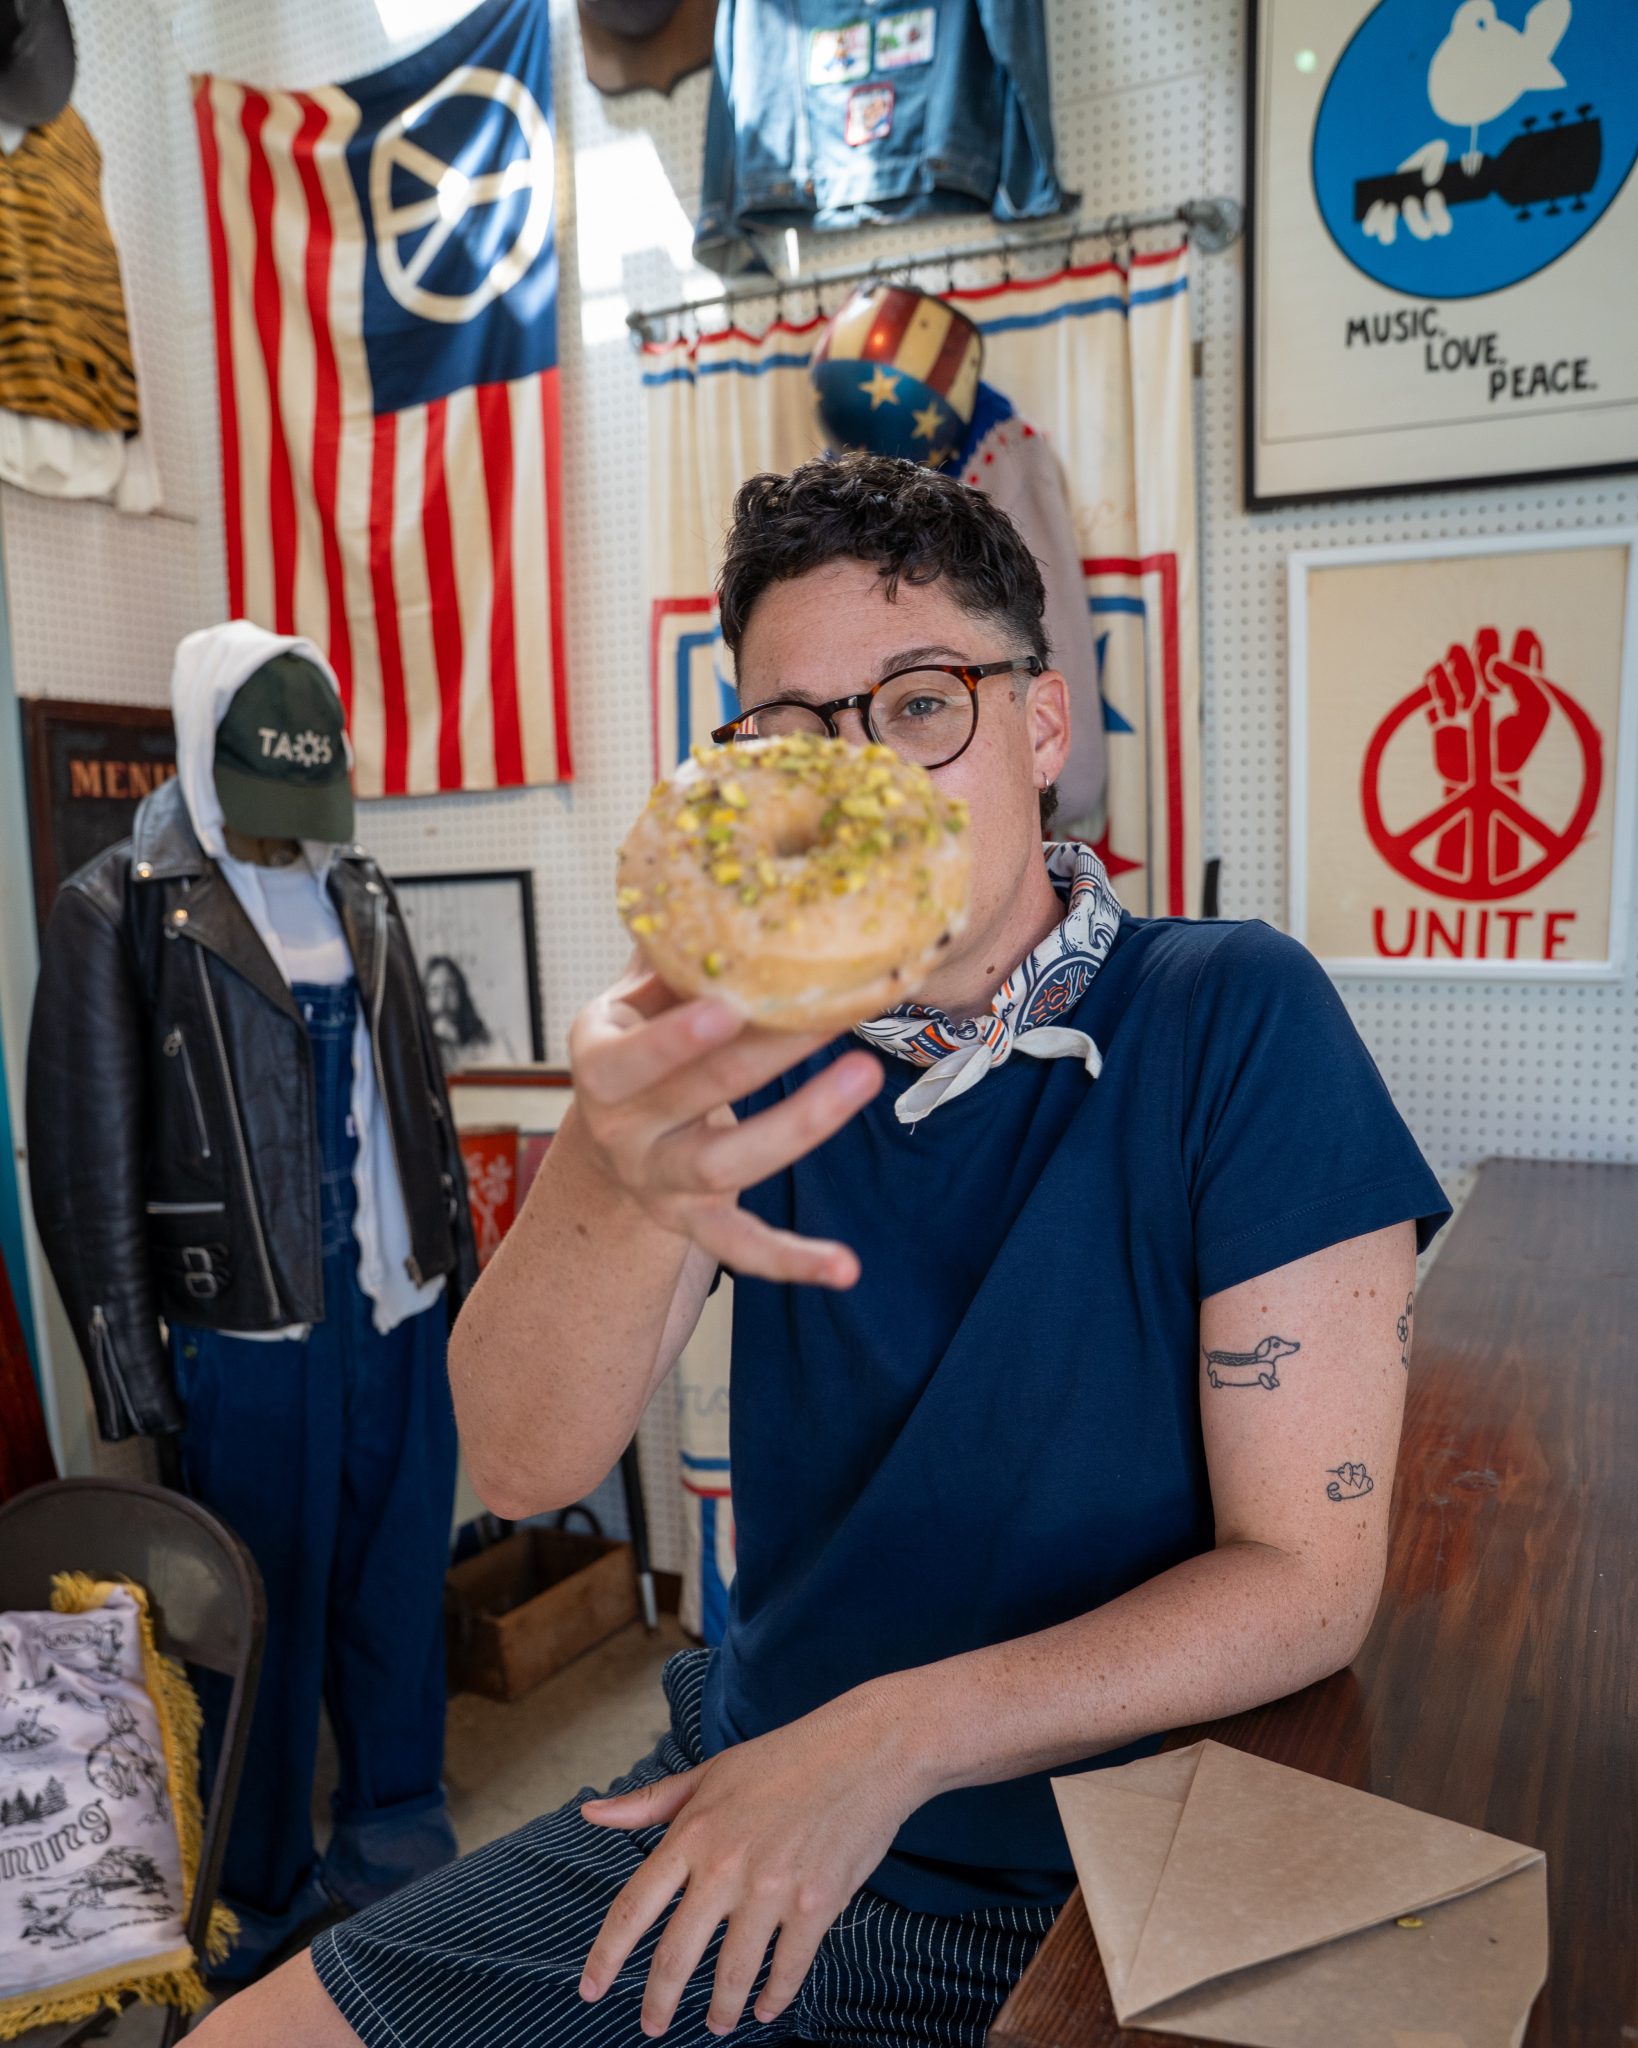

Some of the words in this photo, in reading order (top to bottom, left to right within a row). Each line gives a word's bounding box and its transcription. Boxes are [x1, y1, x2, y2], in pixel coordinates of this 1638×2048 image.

[1346, 306, 1447, 347] MUSIC.
[1425, 332, 1507, 372] LOVE.
[1489, 358, 1598, 402] PEACE.
[1372, 908, 1577, 961] UNITE
